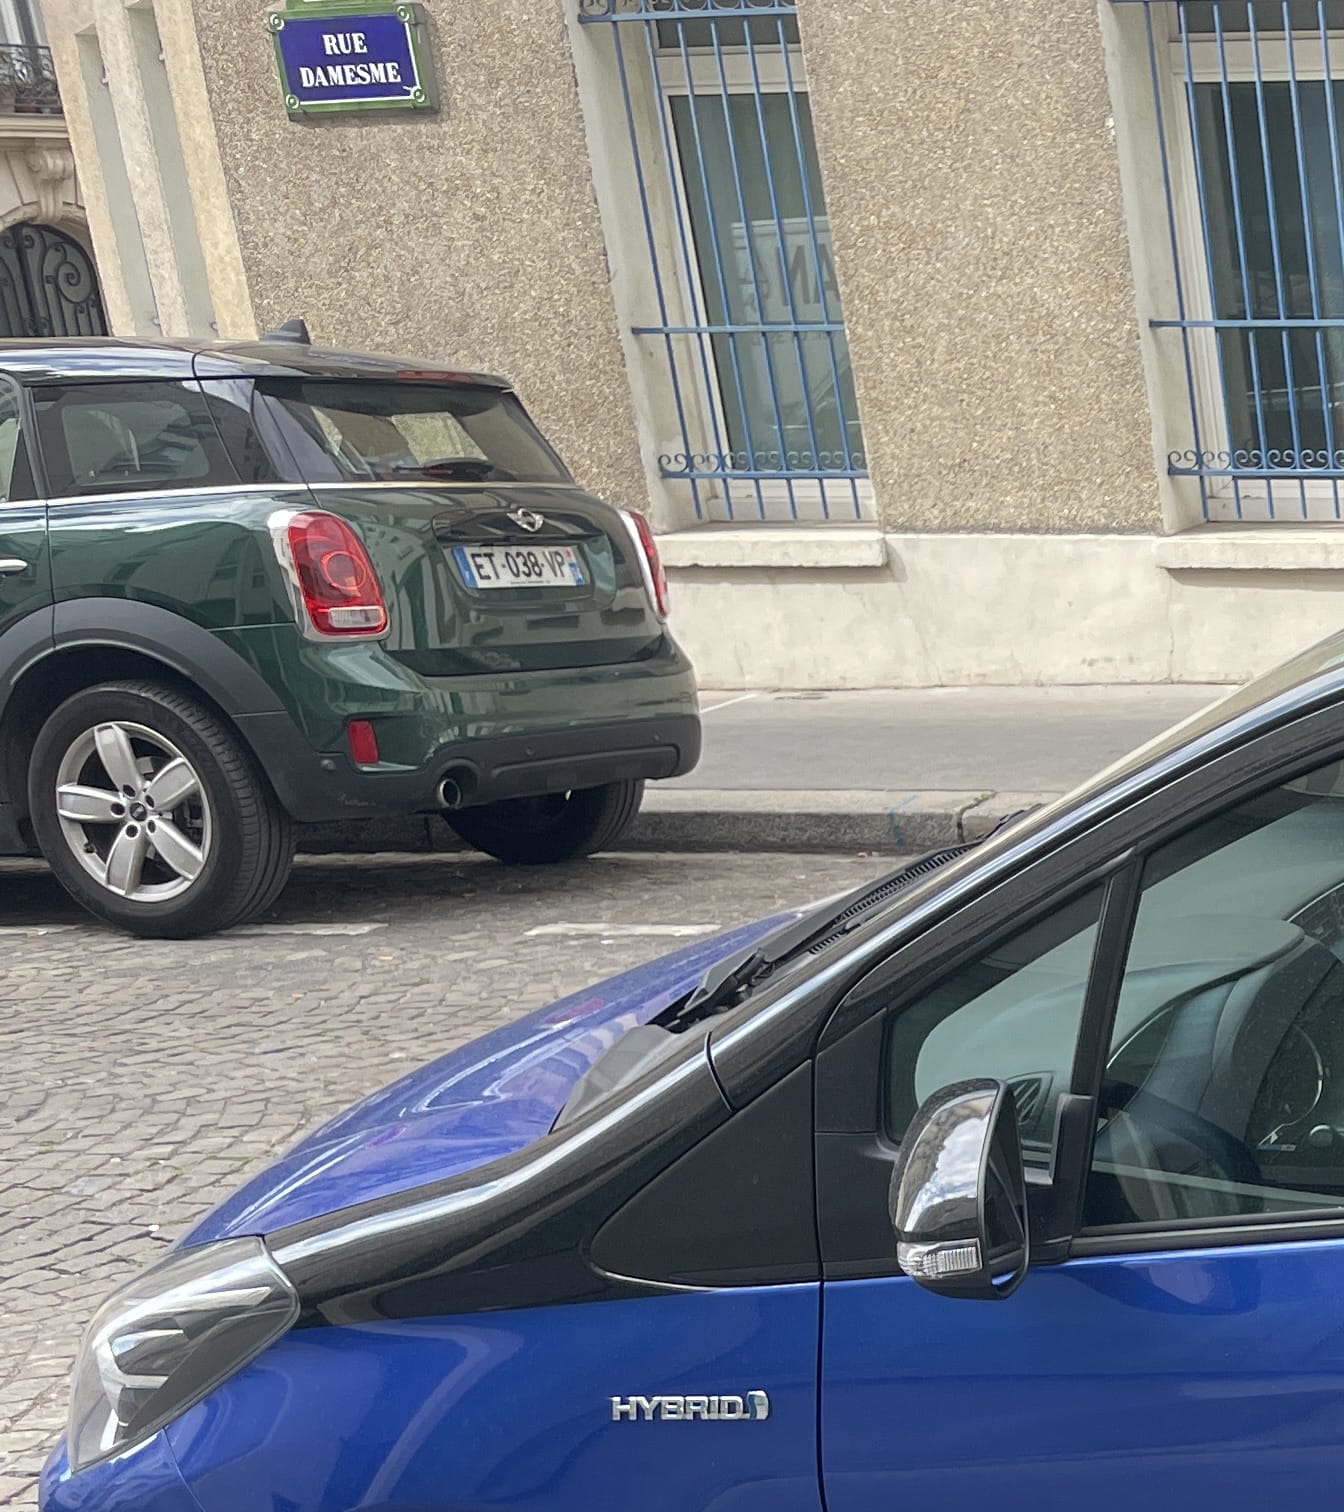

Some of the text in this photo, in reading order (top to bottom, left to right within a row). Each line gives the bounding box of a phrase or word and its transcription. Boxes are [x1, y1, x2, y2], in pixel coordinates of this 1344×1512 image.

[322, 32, 368, 55] RUE
[300, 62, 402, 88] DAMESME
[611, 1395, 745, 1421] HYBRID
